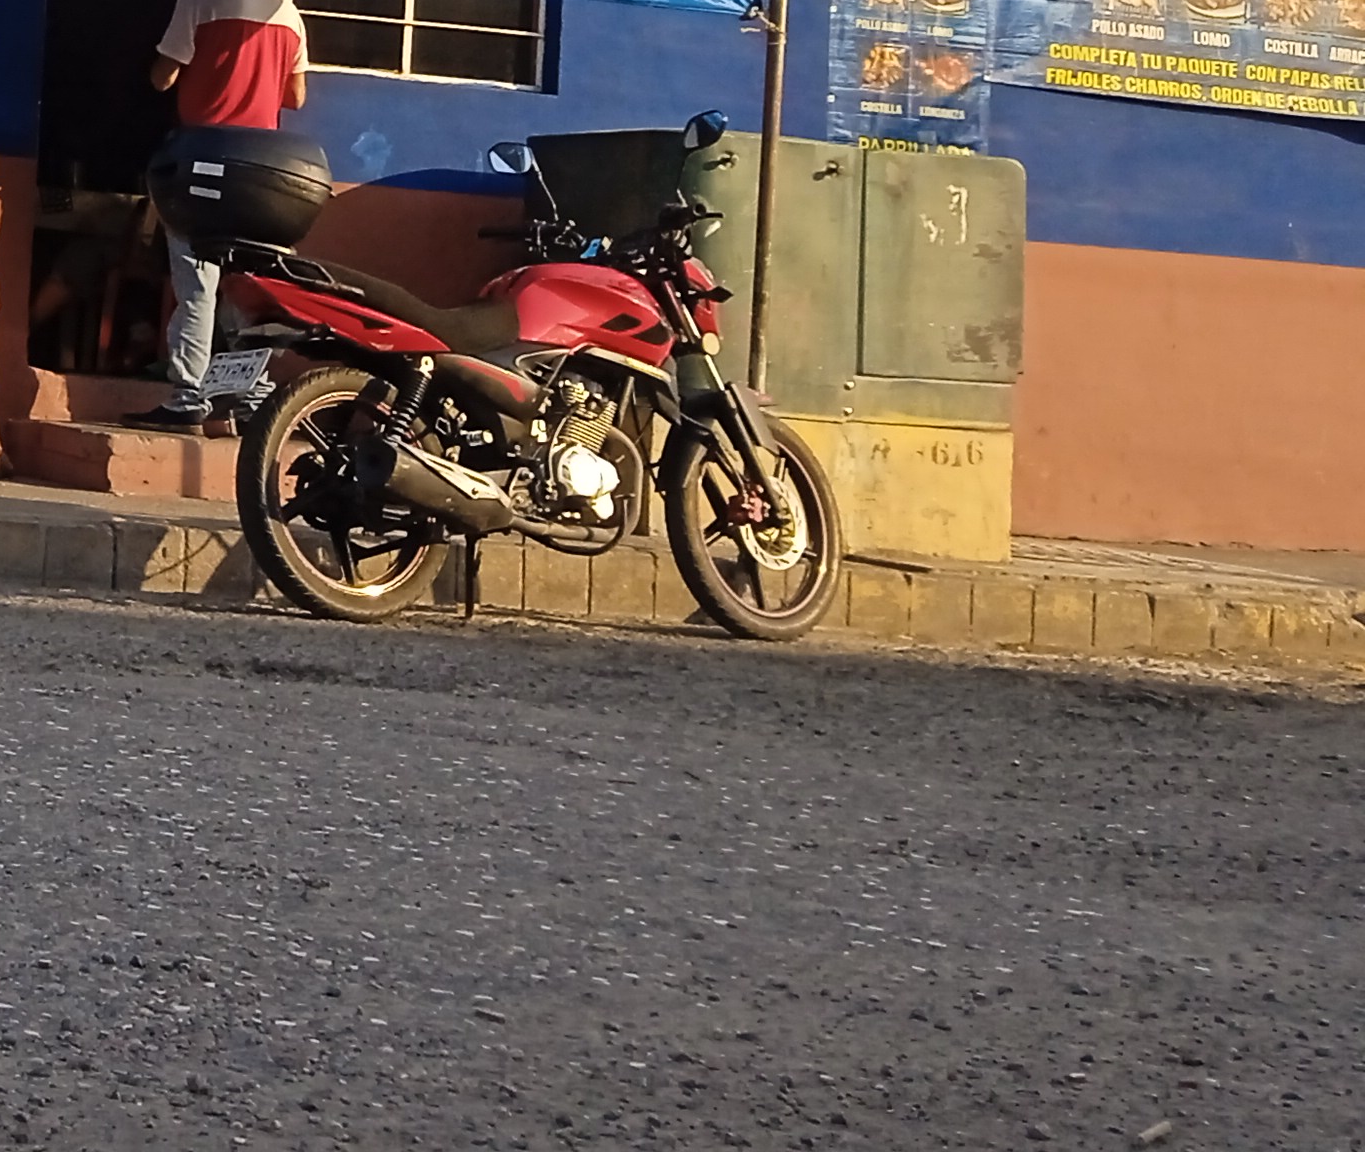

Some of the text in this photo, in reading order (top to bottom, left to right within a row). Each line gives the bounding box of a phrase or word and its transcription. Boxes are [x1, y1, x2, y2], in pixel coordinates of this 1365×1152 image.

[1092, 19, 1165, 41] POLLO ASADO
[1193, 30, 1231, 48] LOMO
[1264, 38, 1319, 59] COSTILLA
[1049, 43, 1137, 68] COMPLETA
[1141, 53, 1162, 70] TU
[1166, 55, 1238, 79] PAQUETE
[1245, 64, 1277, 84] CON
[1279, 68, 1331, 90] PAPAS
[1046, 67, 1123, 92] FRIJOLES
[1210, 85, 1263, 106] ORDEN
[1265, 92, 1287, 109] DE
[1288, 94, 1359, 116] CEBOLLA
